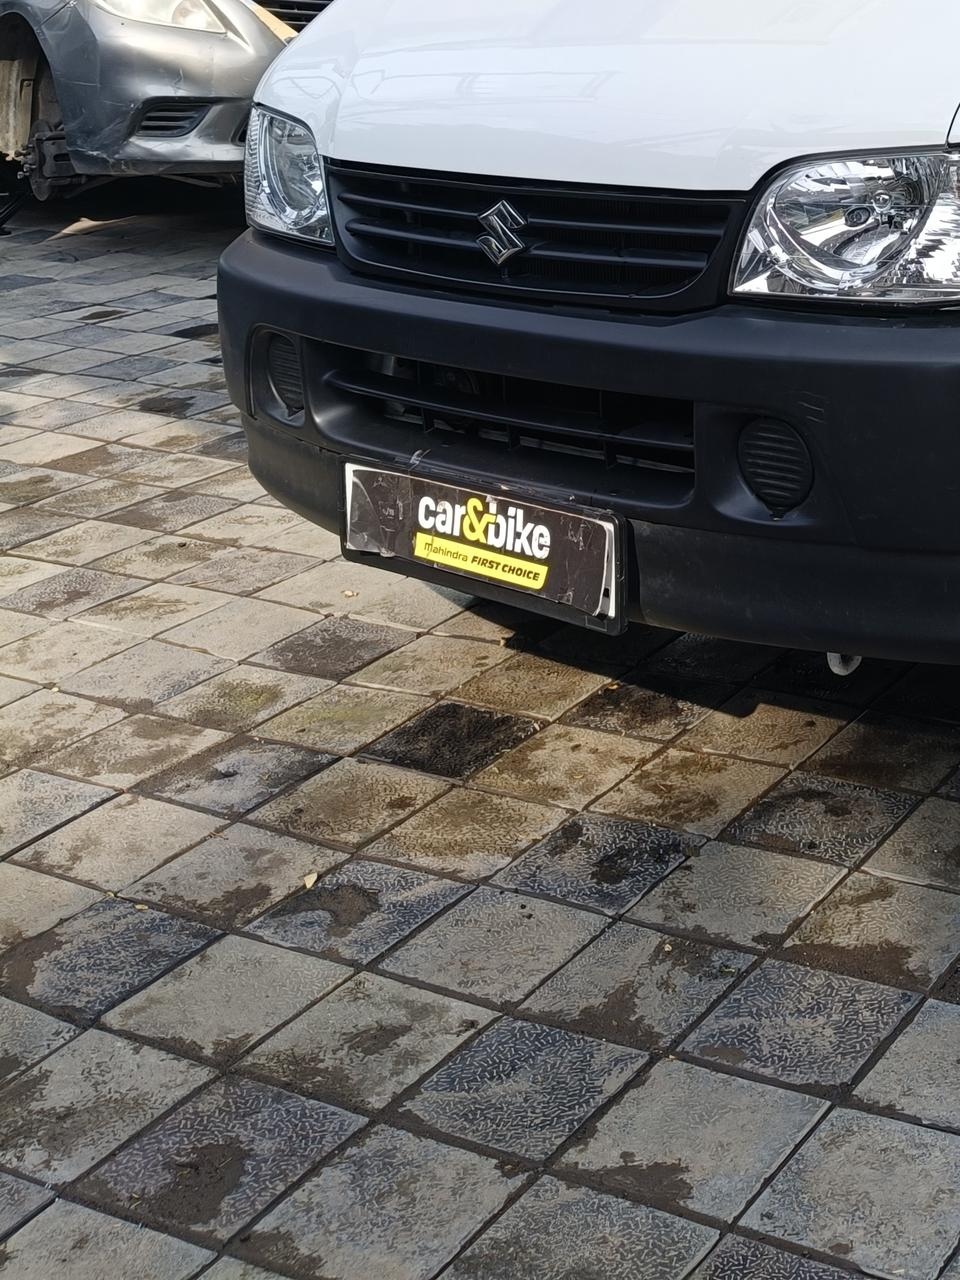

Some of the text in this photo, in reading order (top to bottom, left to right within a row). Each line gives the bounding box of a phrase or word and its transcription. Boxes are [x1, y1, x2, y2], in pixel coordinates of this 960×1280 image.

[418, 496, 551, 560] car&bike
[471, 556, 501, 571] FIRST
[501, 564, 541, 582] CHOICE
